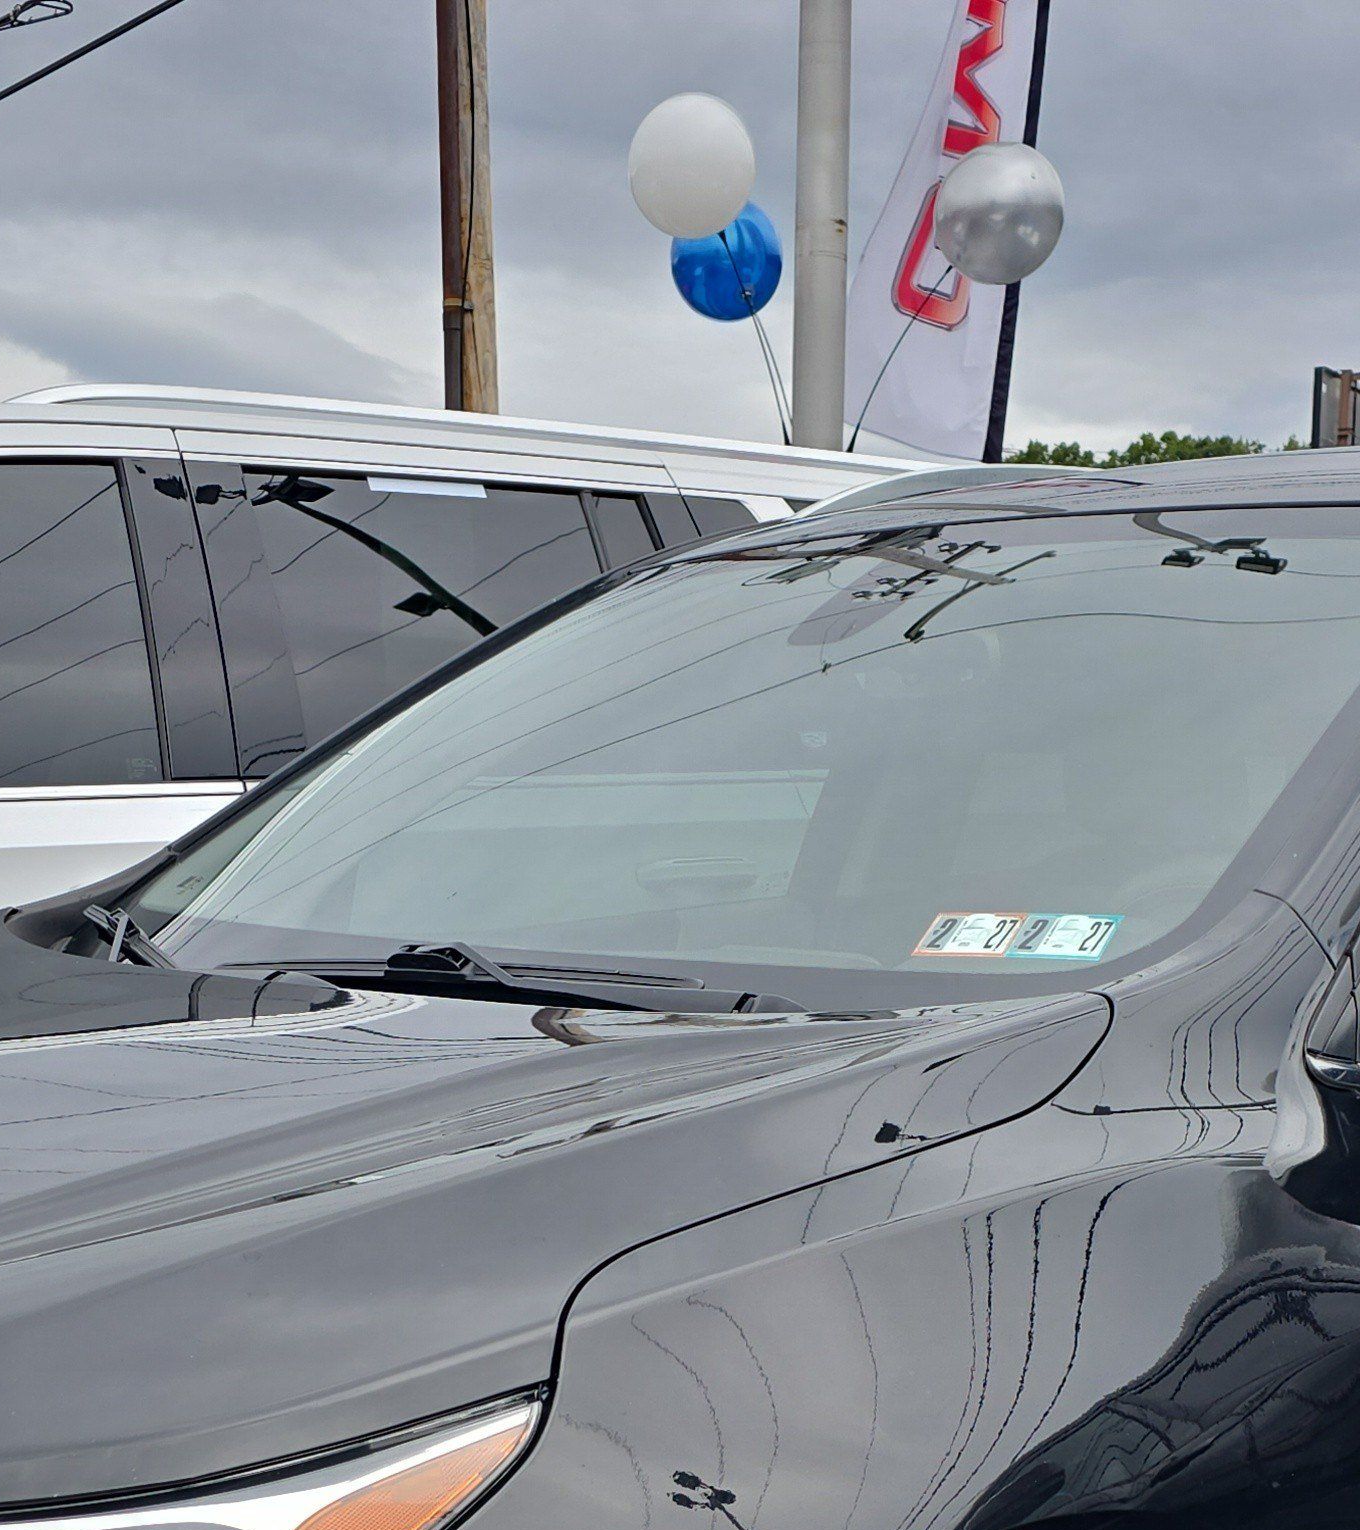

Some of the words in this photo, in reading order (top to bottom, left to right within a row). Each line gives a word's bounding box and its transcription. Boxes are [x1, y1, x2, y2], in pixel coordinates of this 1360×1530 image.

[925, 918, 958, 950] 2
[983, 919, 1019, 951] 27
[1017, 919, 1050, 950] 2
[1078, 921, 1115, 952] 27
